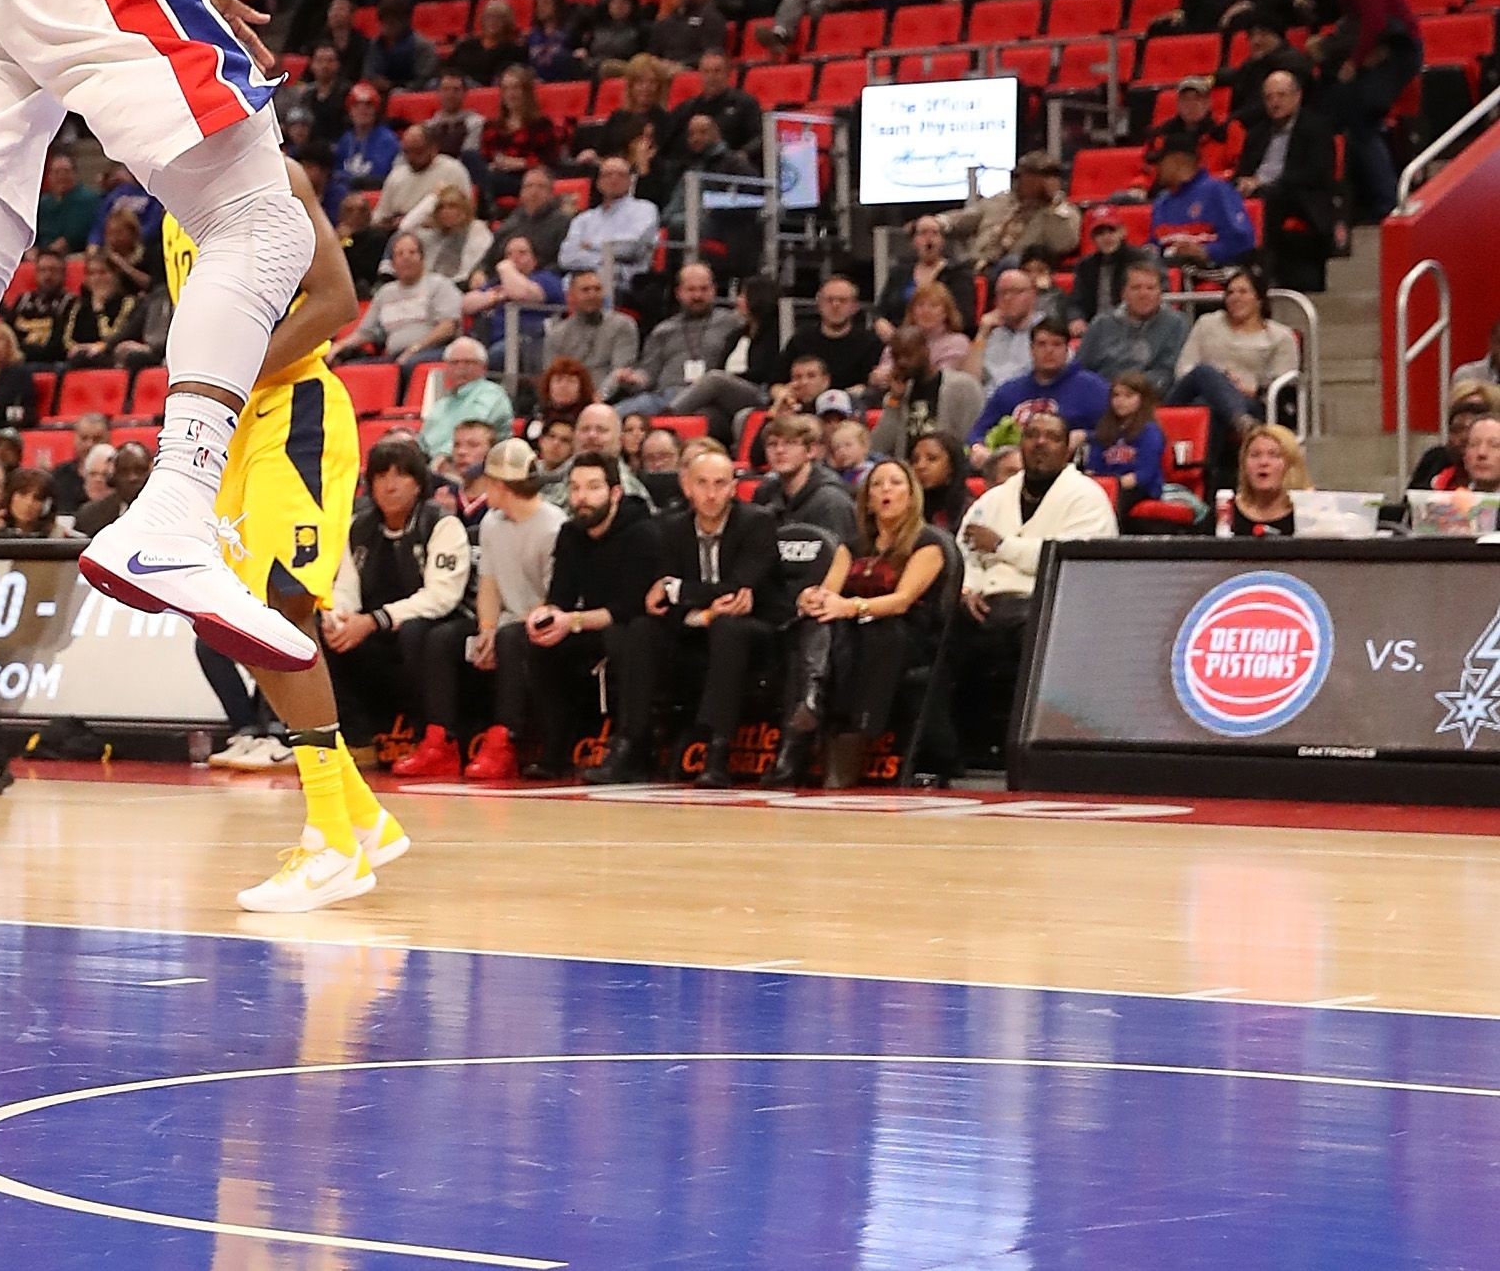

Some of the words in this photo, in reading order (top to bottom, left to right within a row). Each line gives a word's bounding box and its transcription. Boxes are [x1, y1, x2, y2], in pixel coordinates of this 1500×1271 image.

[1209, 627, 1301, 653] DETROIT
[1204, 652, 1299, 679] PISTONS
[1364, 638, 1424, 673] VS.
